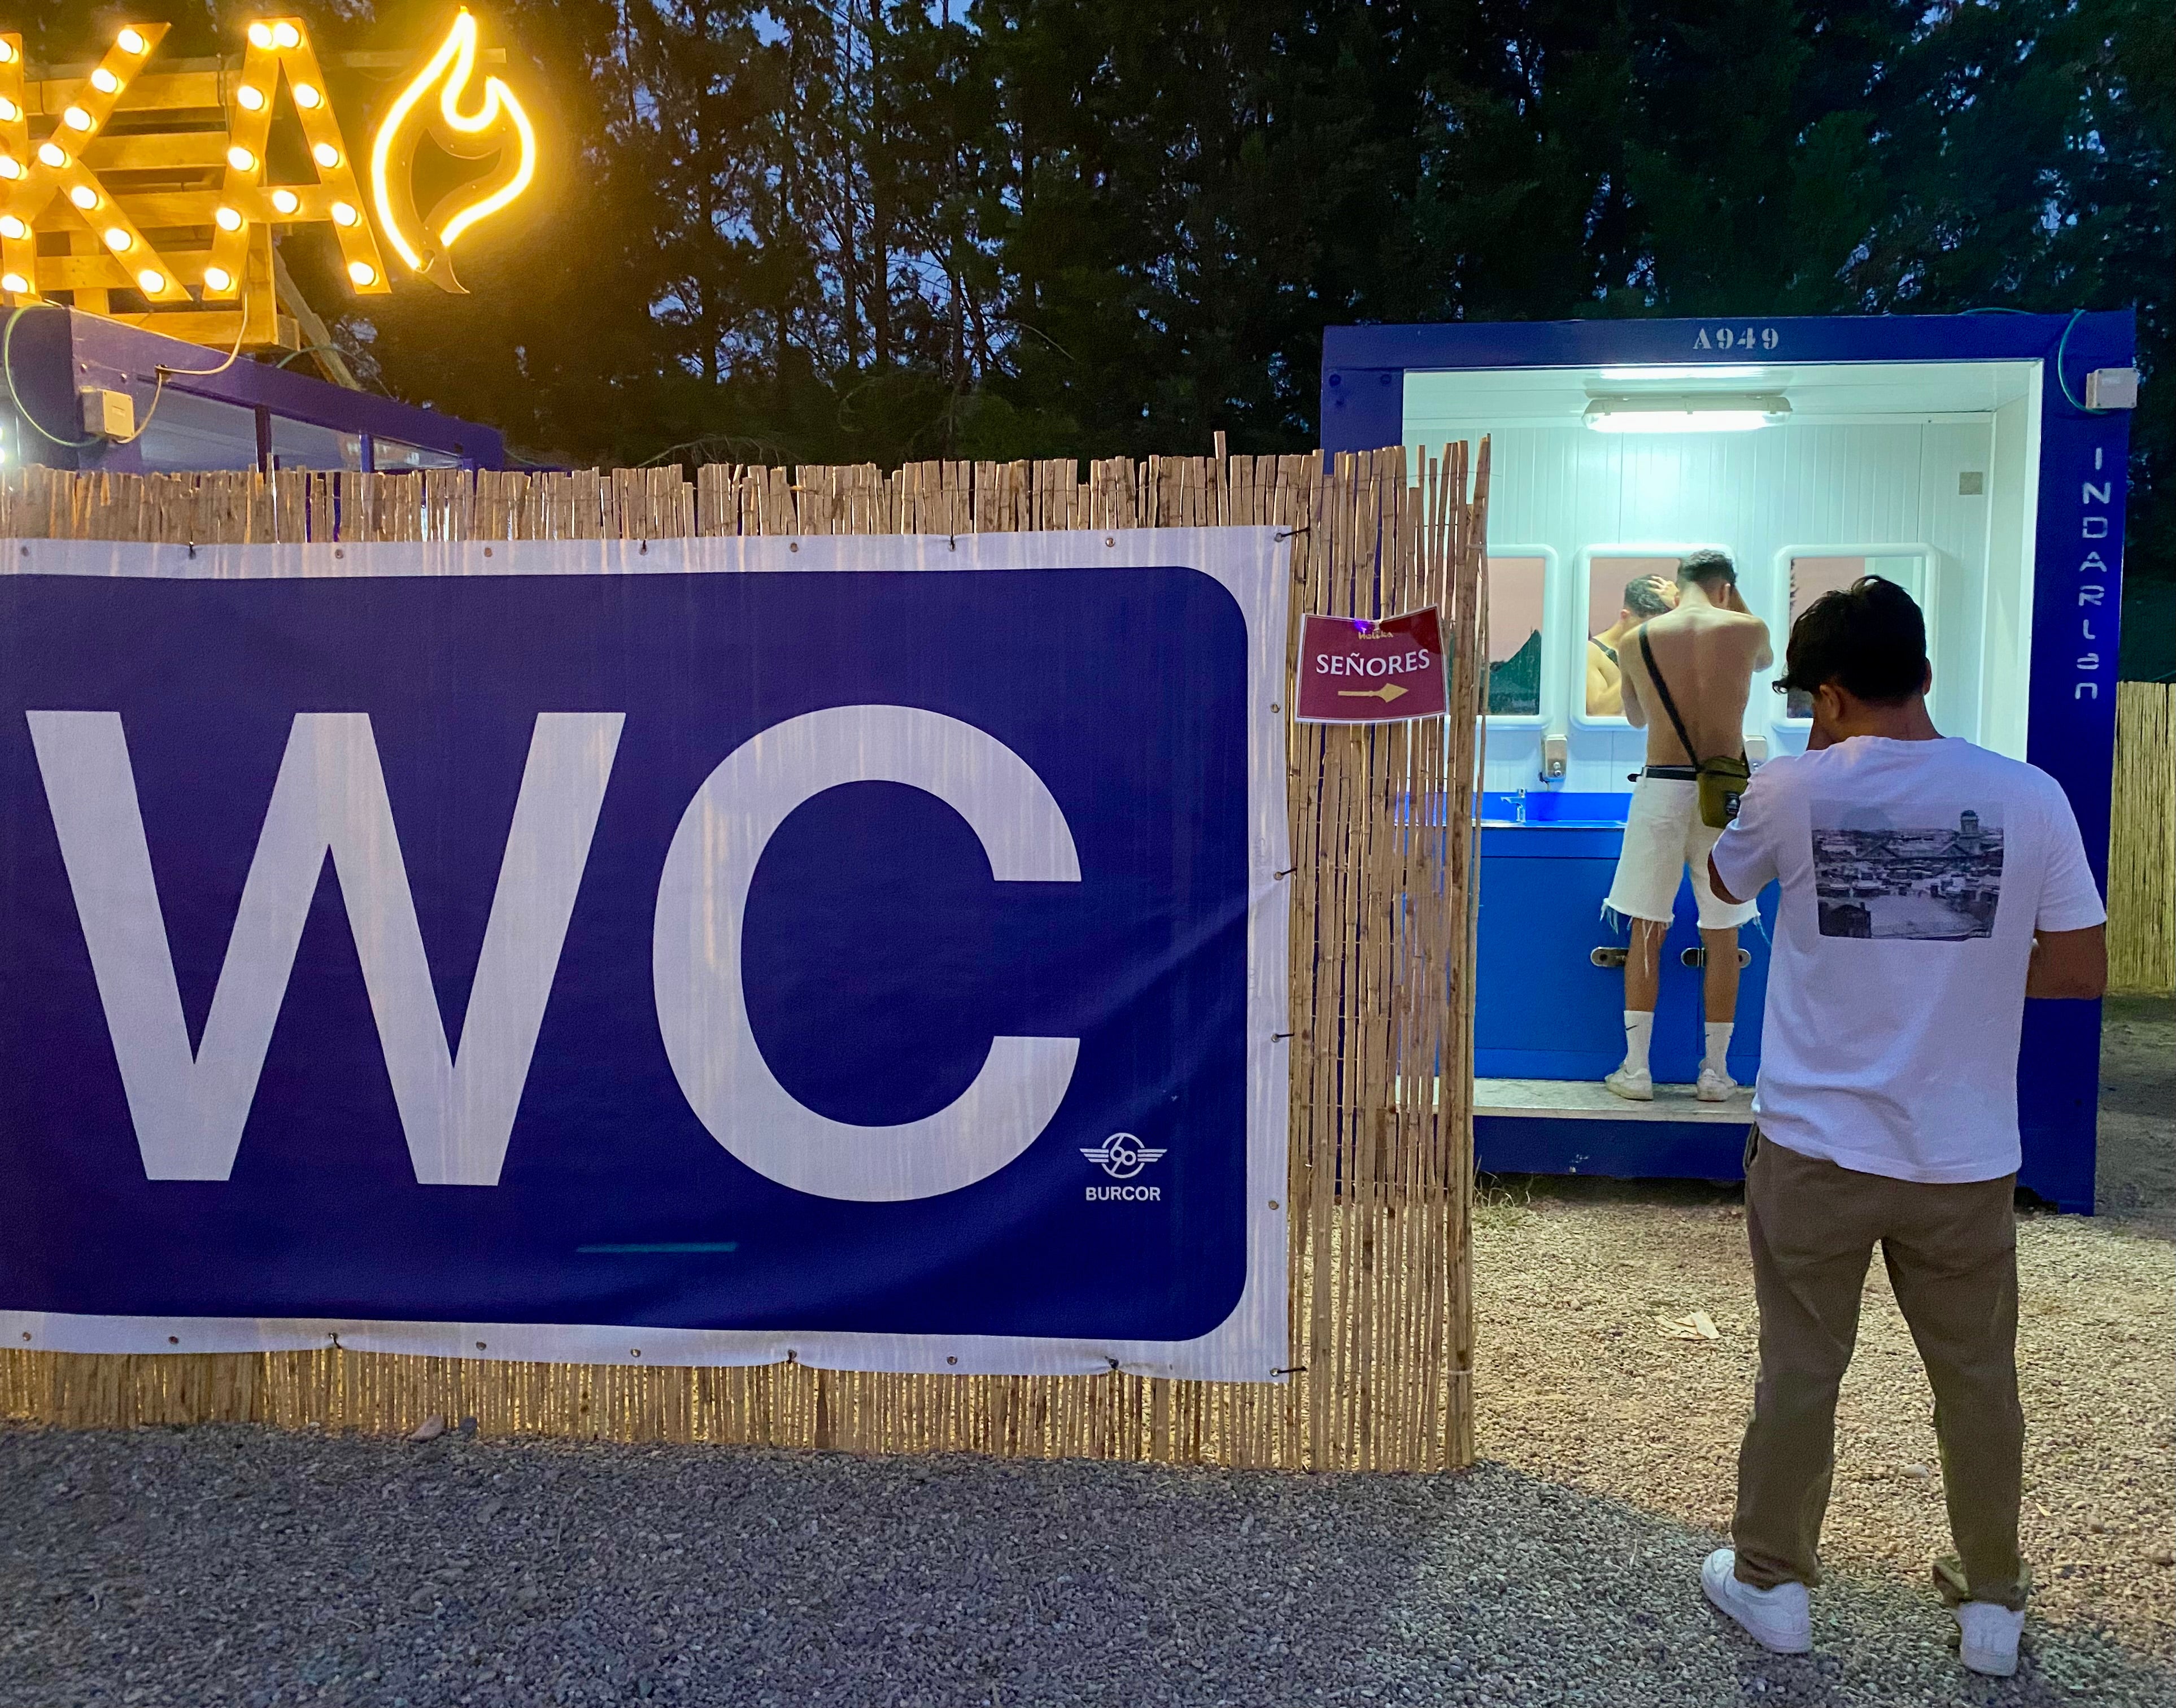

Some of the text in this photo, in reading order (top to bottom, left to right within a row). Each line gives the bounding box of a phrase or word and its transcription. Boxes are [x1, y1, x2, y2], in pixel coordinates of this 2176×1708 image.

[1693, 327, 1779, 350] A949
[1316, 649, 1430, 676] SEÑORES
[26, 704, 1082, 1202] WC
[1085, 1186, 1161, 1201] BURCOR
